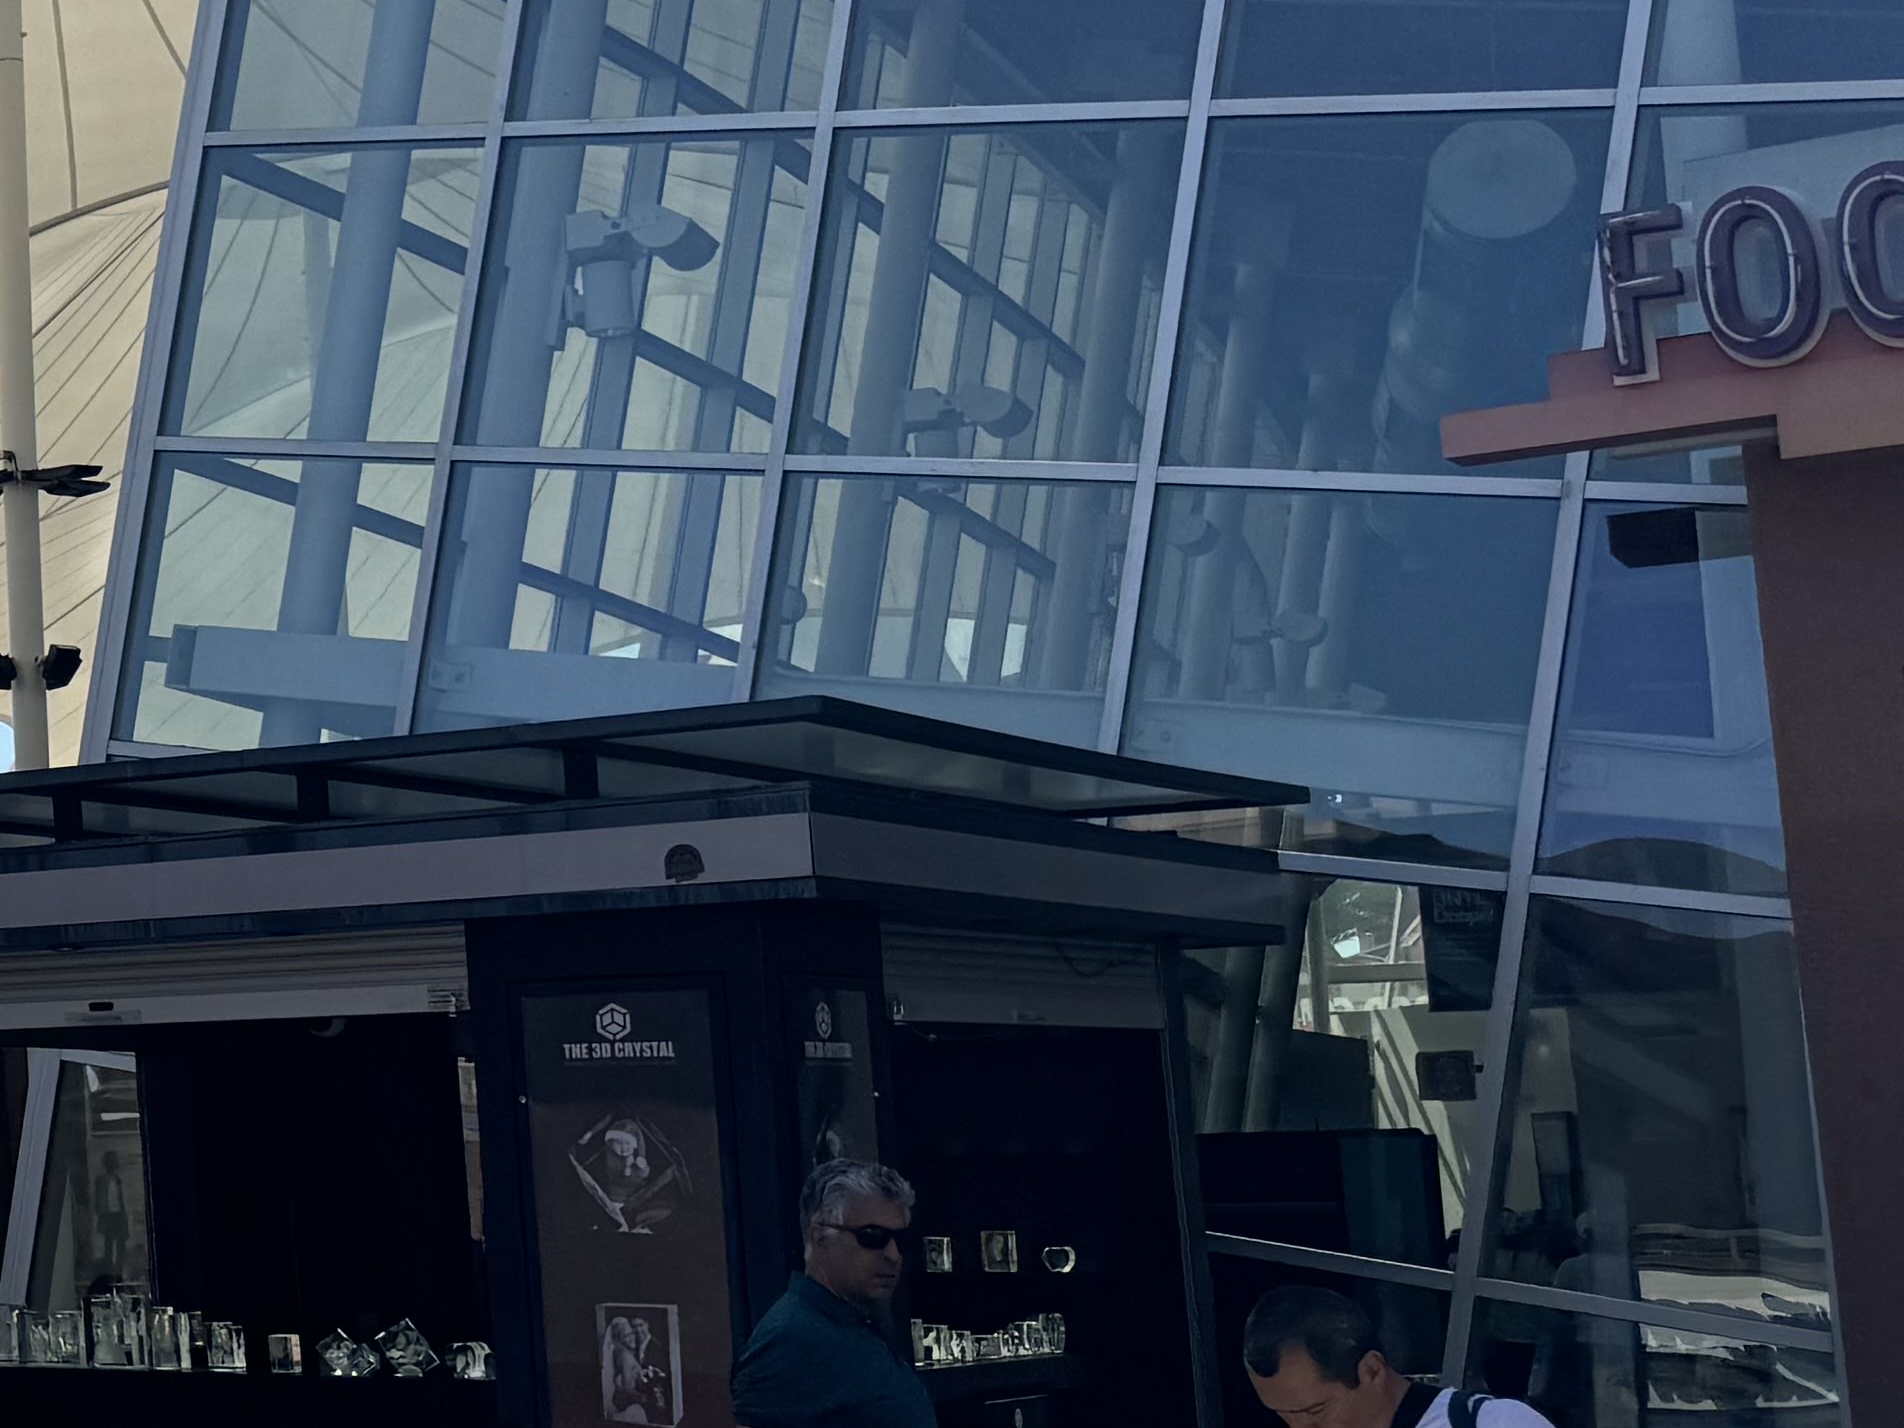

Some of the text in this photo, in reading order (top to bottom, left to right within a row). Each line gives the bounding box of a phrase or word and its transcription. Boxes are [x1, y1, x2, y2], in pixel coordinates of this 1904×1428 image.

[563, 1040, 676, 1060] THE 3D CRYSTAL
